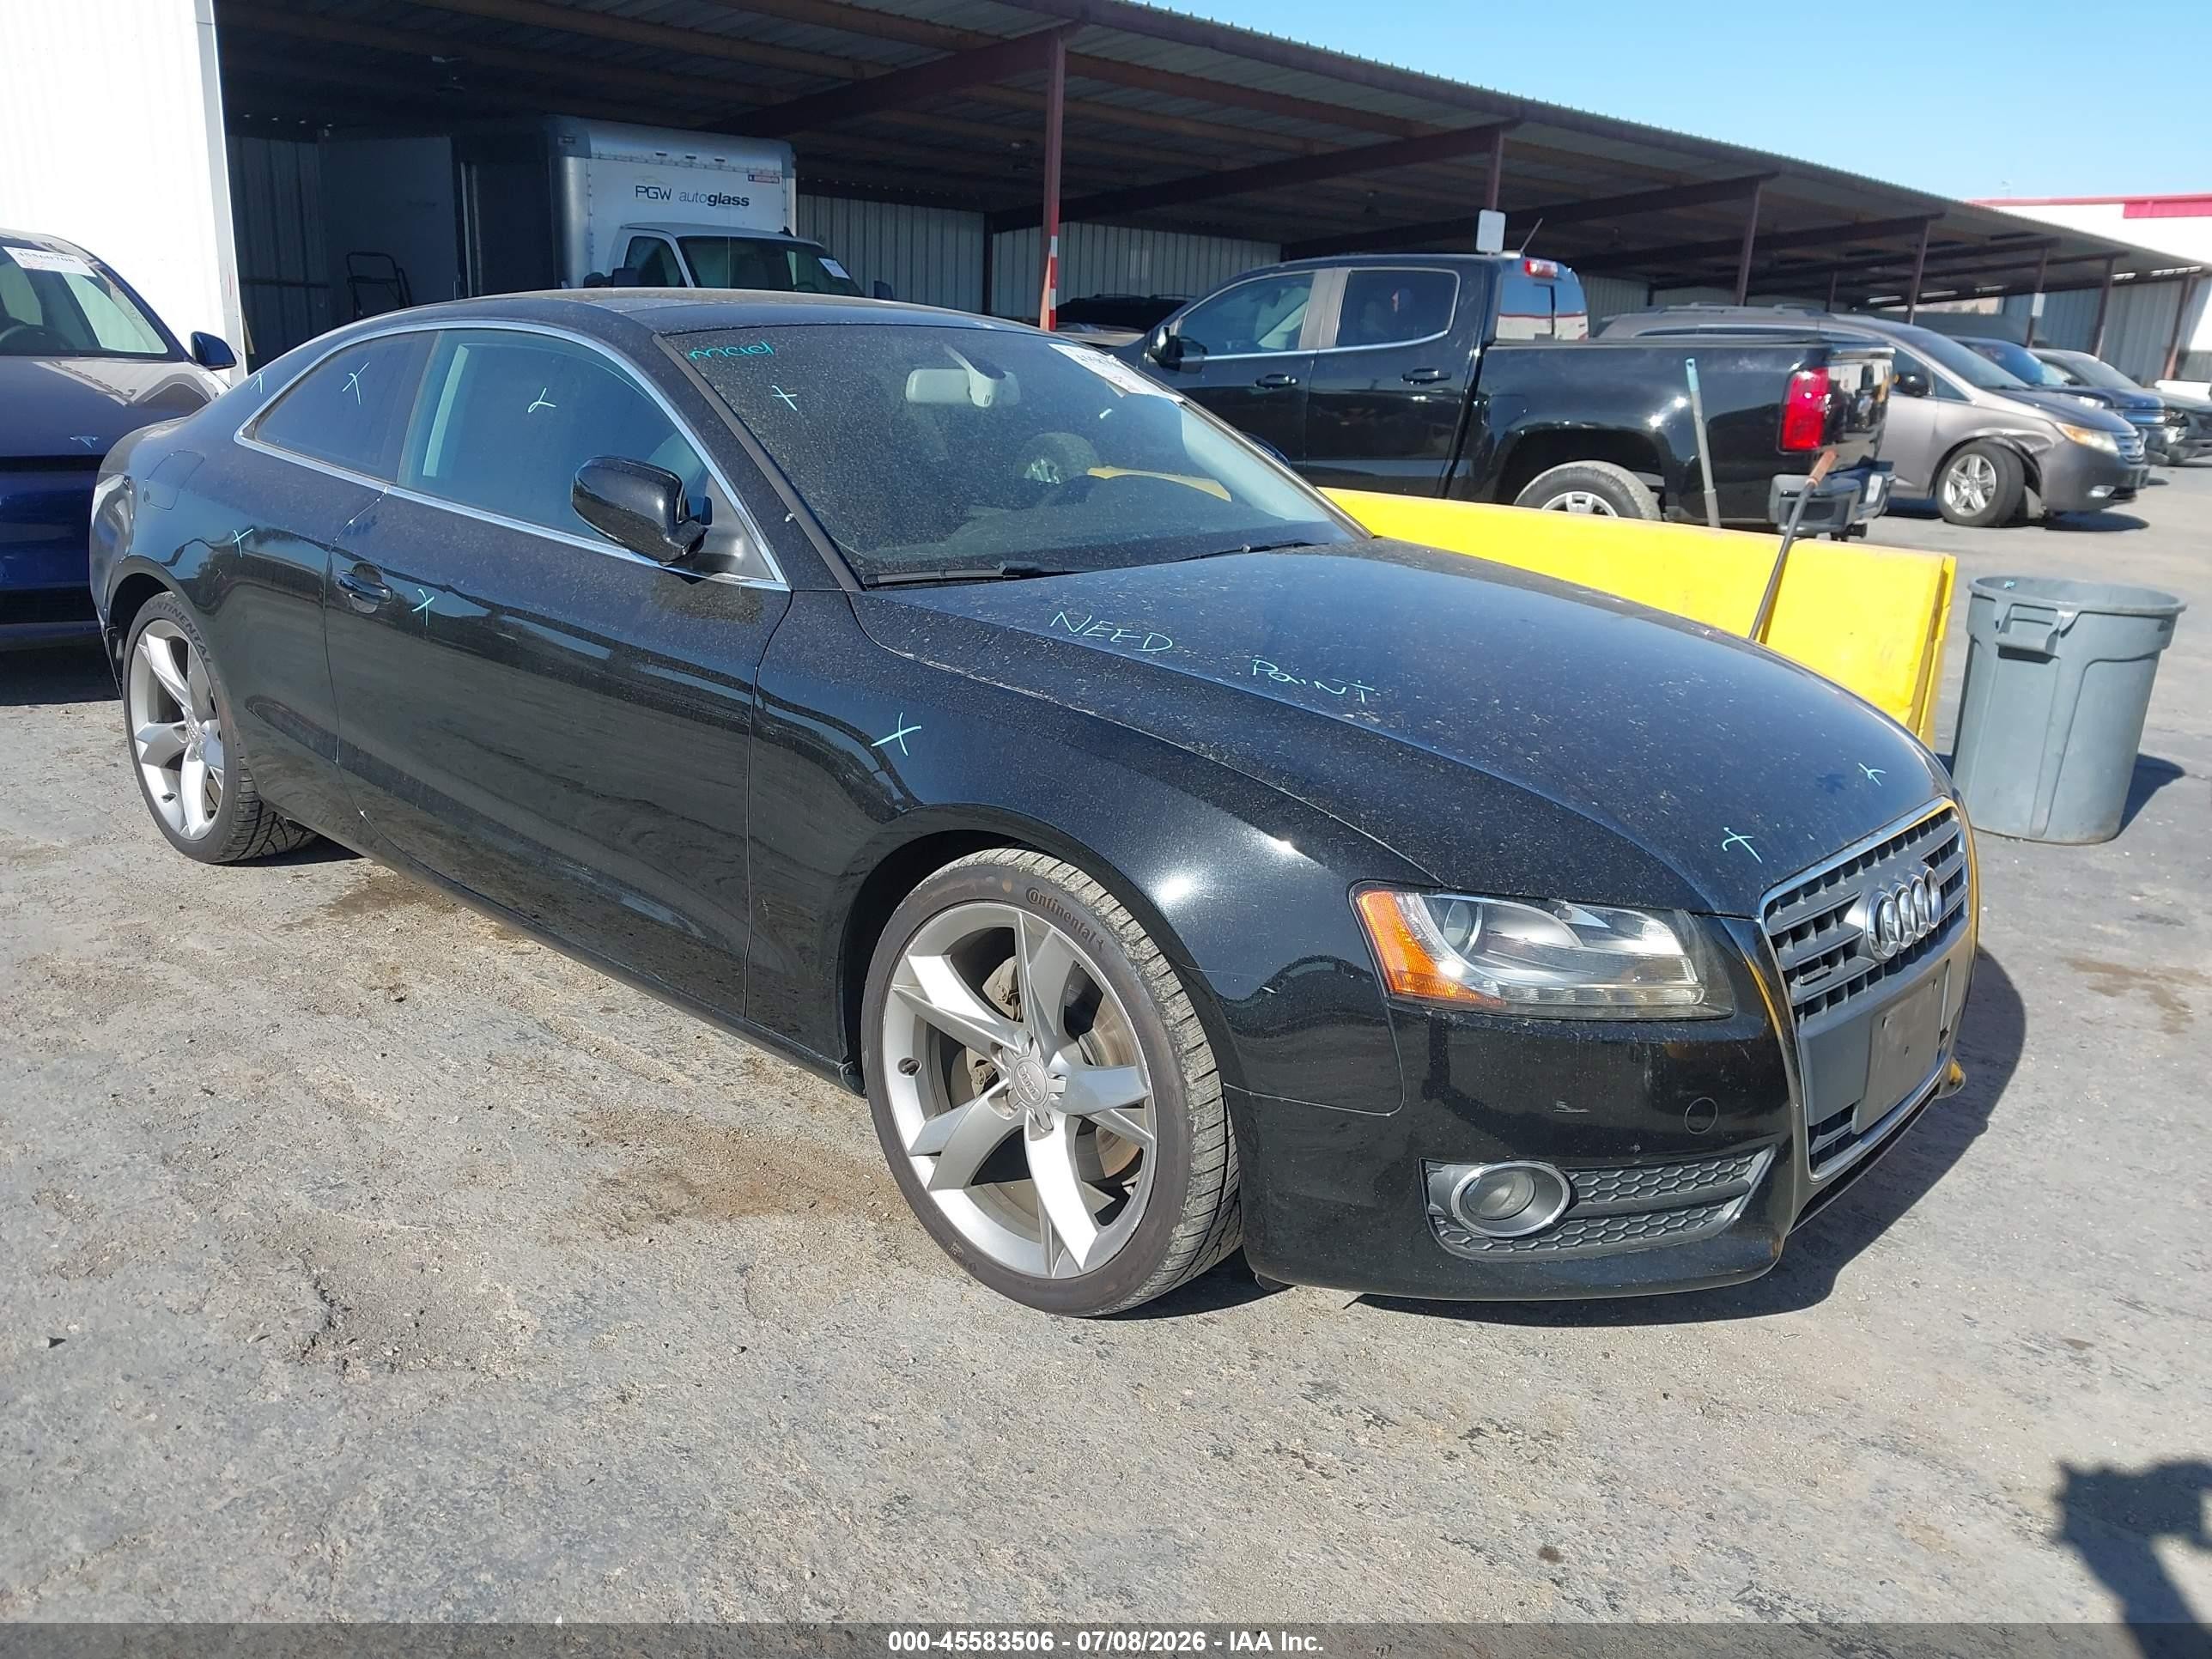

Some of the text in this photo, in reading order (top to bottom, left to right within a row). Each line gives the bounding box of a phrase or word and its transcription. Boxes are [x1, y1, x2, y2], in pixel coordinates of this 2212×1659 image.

[635, 185, 750, 207] PGW autoglass
[1049, 611, 1173, 652] NEED
[1025, 886, 1097, 944] Continental
